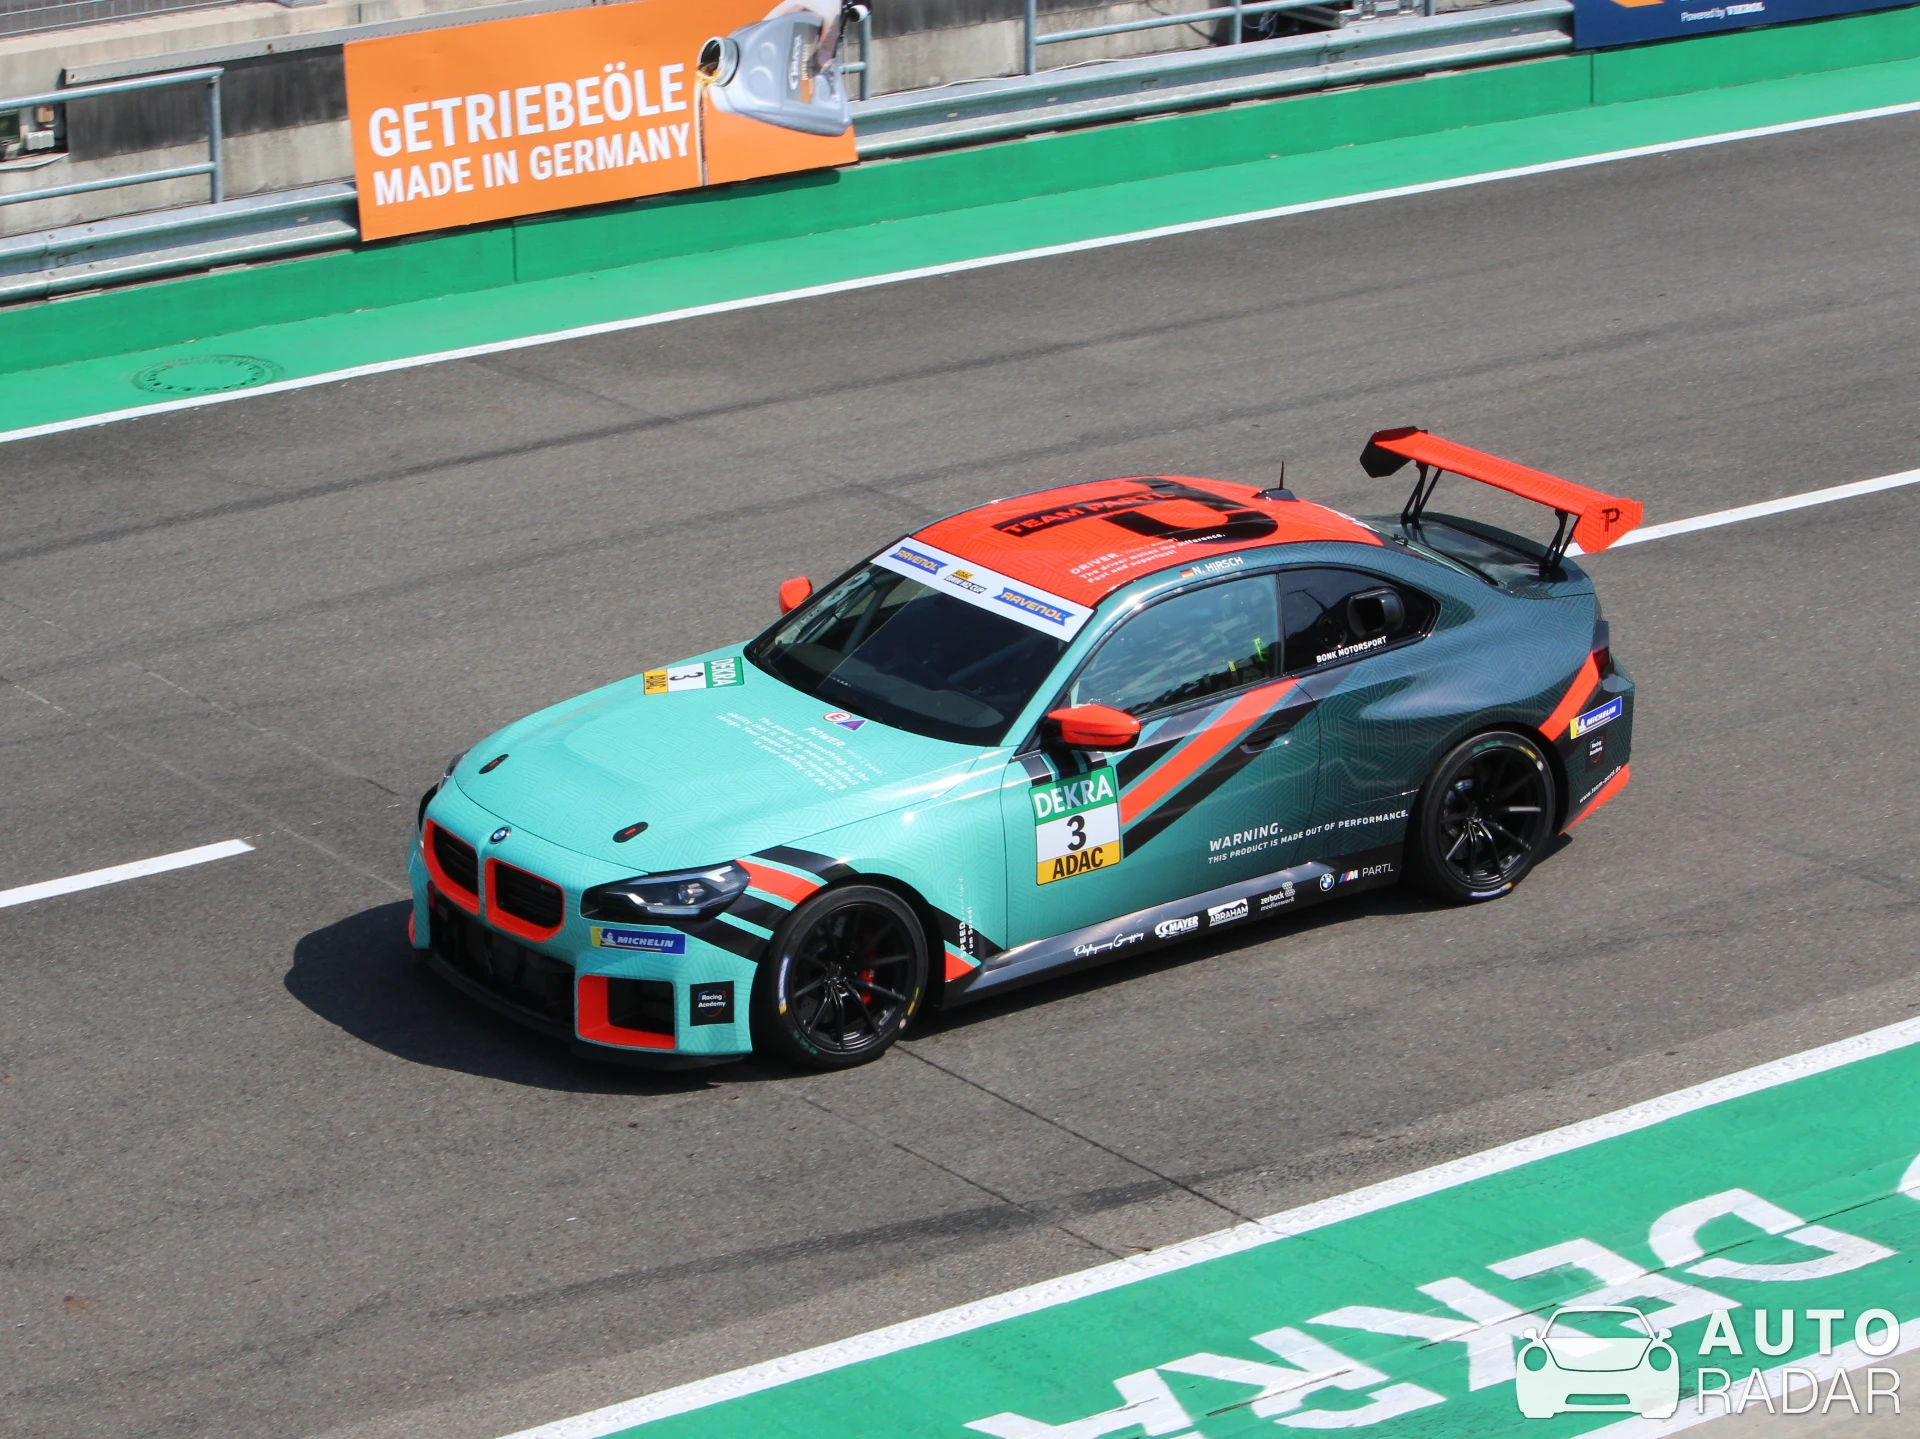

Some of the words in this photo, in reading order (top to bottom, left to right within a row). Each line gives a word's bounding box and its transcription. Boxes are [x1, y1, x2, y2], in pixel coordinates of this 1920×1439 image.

[369, 61, 687, 158] GETRIEBEÖLE
[373, 156, 475, 207] MADE
[482, 149, 518, 189] IN
[528, 121, 692, 182] GERMANY
[1001, 508, 1085, 533] TEAM
[1086, 492, 1176, 512] PARTL
[895, 549, 939, 571] RAVENOL
[1069, 552, 1123, 575] DRIVER.
[1079, 569, 1099, 579] The
[1100, 558, 1127, 571] driver
[1129, 549, 1158, 560] makes
[1177, 533, 1226, 547] difference.
[1191, 565, 1205, 575] N.
[1204, 556, 1244, 573] HIRSCH
[1087, 571, 1110, 584] Fast
[1111, 564, 1128, 573] and
[1001, 591, 1063, 621] RAVENOL
[1316, 649, 1337, 663] BONK
[1338, 635, 1387, 657] MOTORSPORT
[669, 671, 704, 681] 3
[711, 657, 737, 687] DEKRA
[1586, 705, 1617, 726] MICHELIN
[1033, 774, 1114, 819] DEKRA
[1066, 815, 1087, 851] 3
[1207, 853, 1228, 864] THIS
[1229, 841, 1269, 859] PRODUCT
[1270, 839, 1278, 847] IS
[1280, 831, 1303, 844] MADE
[1305, 825, 1323, 837] OUT
[1324, 822, 1335, 831] OF
[1338, 809, 1409, 829] PERFORMANCE.
[1209, 822, 1284, 852] WARNING.
[1052, 846, 1104, 880] ADAC
[1362, 863, 1394, 877] PARTL
[1260, 890, 1284, 905] zerbock
[1168, 915, 1199, 933] MAYER
[1210, 905, 1249, 924] ABRAHAM
[617, 936, 675, 948] MICHELIN
[698, 1001, 727, 1009] Academy
[701, 993, 722, 1001] Racing
